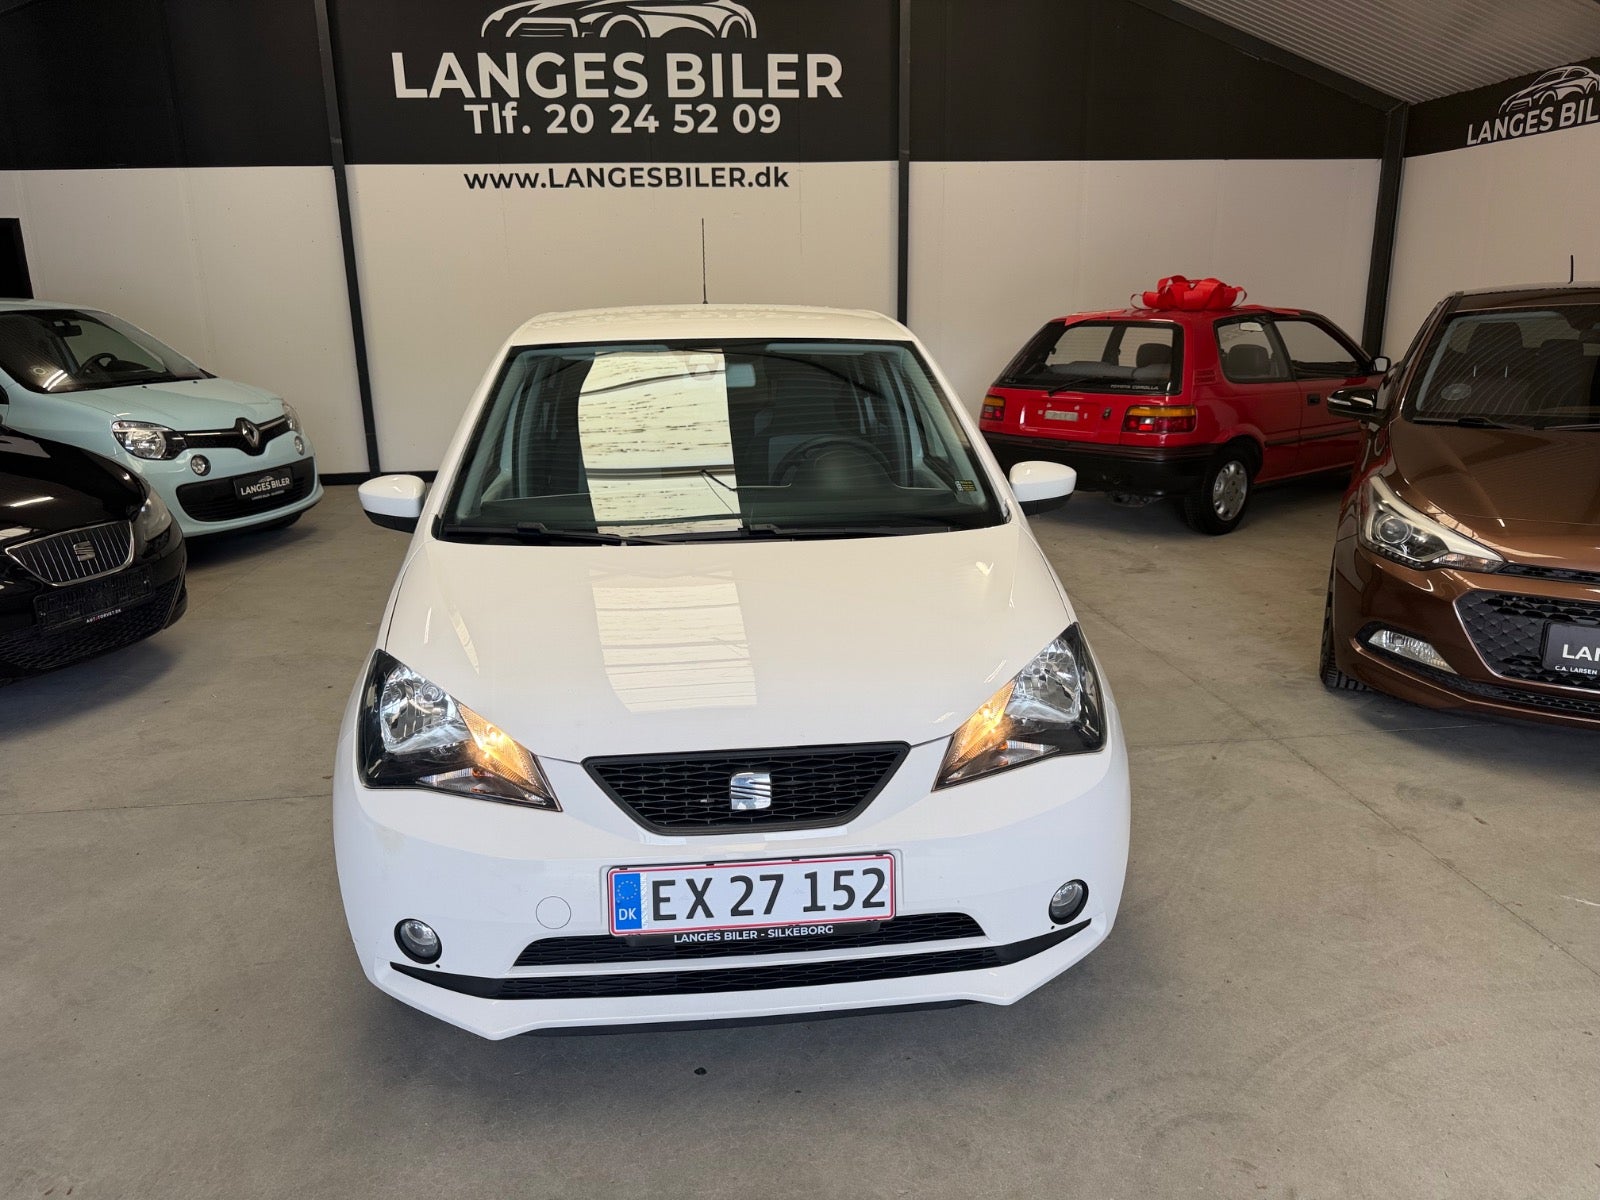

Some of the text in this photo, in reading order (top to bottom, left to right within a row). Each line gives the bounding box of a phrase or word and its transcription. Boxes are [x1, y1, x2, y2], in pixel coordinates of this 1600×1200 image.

[391, 52, 844, 99] LANGES BILER
[464, 103, 782, 135] Tlf. 20 24 52 09
[1466, 107, 1554, 145] LANGES
[464, 166, 790, 190] www.LANGESBILER.dk
[240, 481, 271, 496] LANGES
[270, 477, 290, 489] BILER
[1570, 666, 1598, 675] LARSEN
[652, 867, 886, 921] EX 27 152
[618, 907, 638, 921] DK
[673, 931, 721, 944] LANGES
[724, 929, 758, 941] BILER
[767, 925, 834, 938] SILKEBORG
